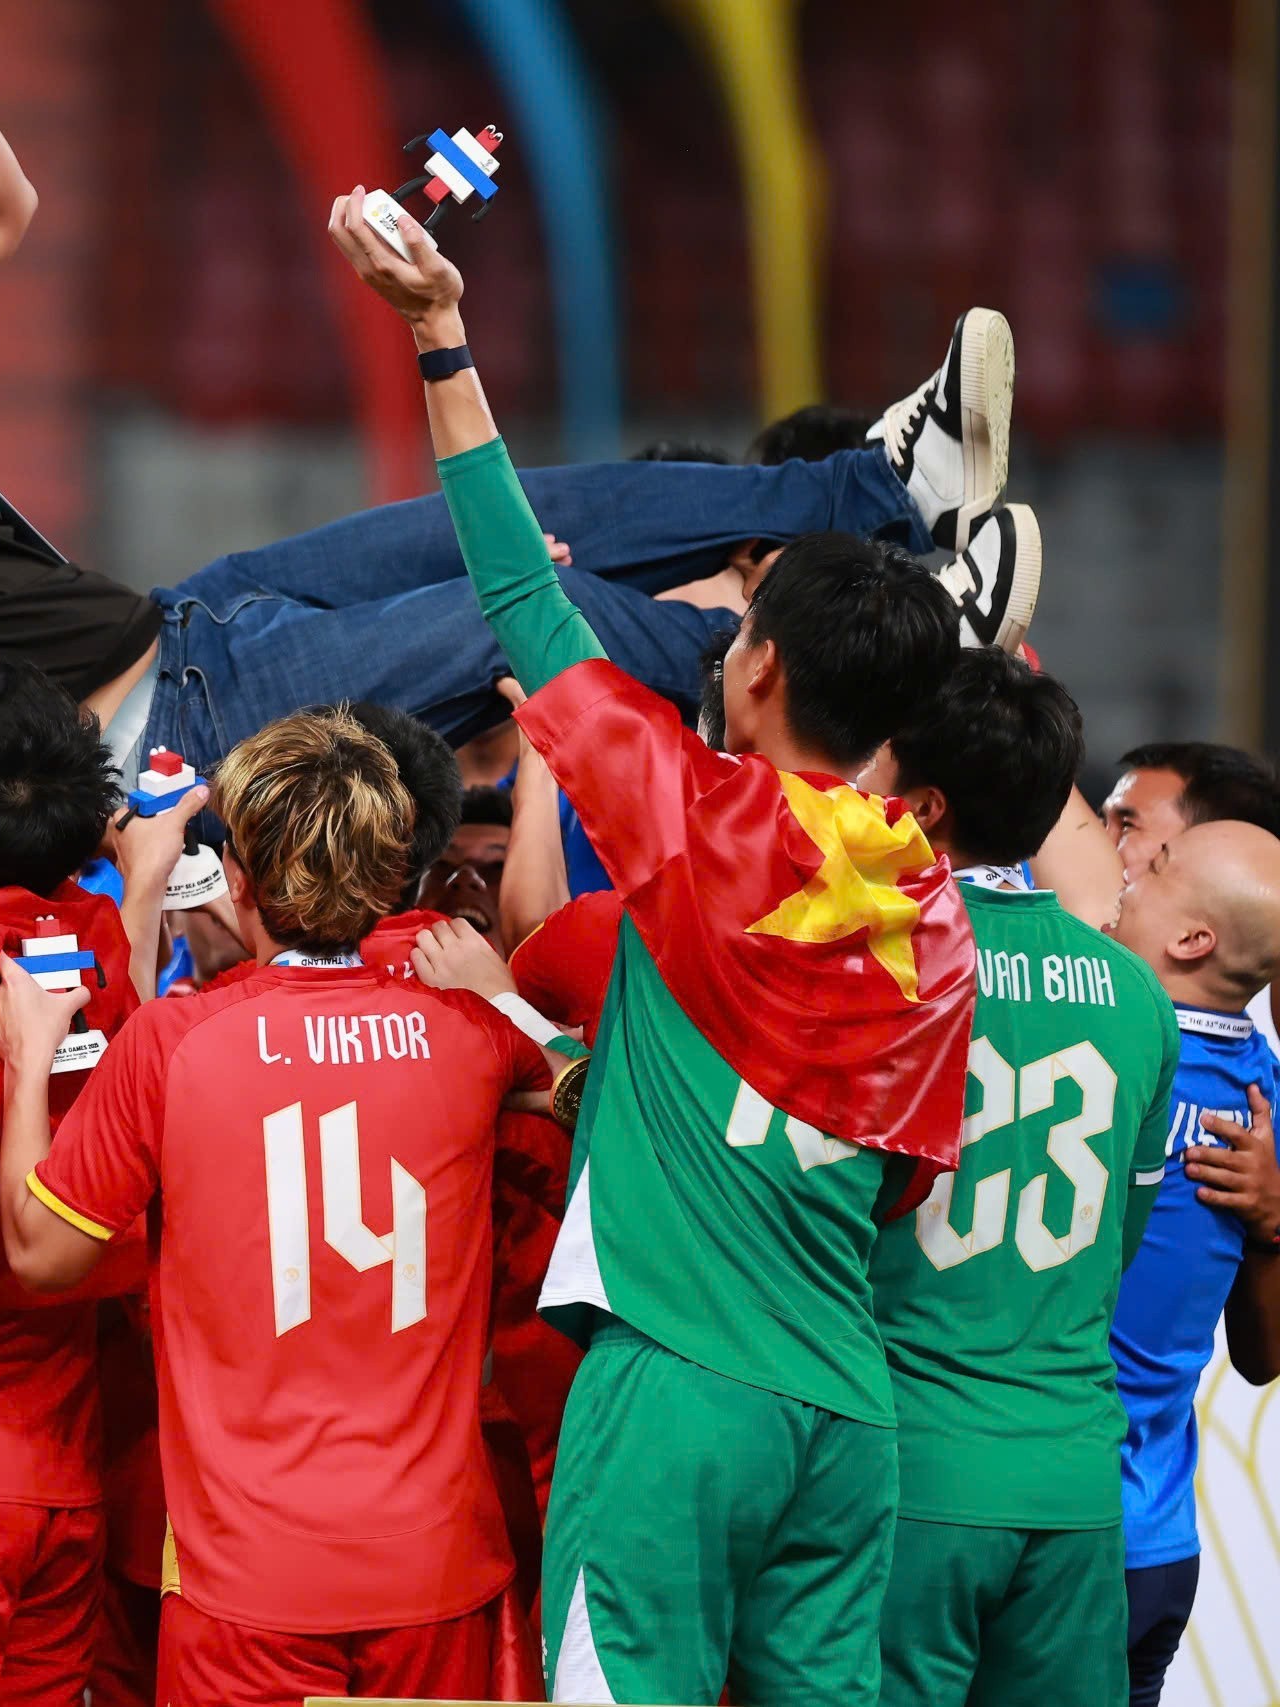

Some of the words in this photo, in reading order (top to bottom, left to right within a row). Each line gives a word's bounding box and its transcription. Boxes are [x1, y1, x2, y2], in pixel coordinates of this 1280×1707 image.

[196, 876, 213, 886] GAMES
[301, 956, 343, 967] THAILAND
[1041, 954, 1116, 1007] BINH
[257, 1016, 292, 1065] L.
[304, 1010, 431, 1065] VIKTOR
[1219, 1023, 1231, 1032] SEA
[68, 1045, 88, 1053] GAMES
[915, 1035, 1118, 1273] 23
[263, 1100, 427, 1338] 14
